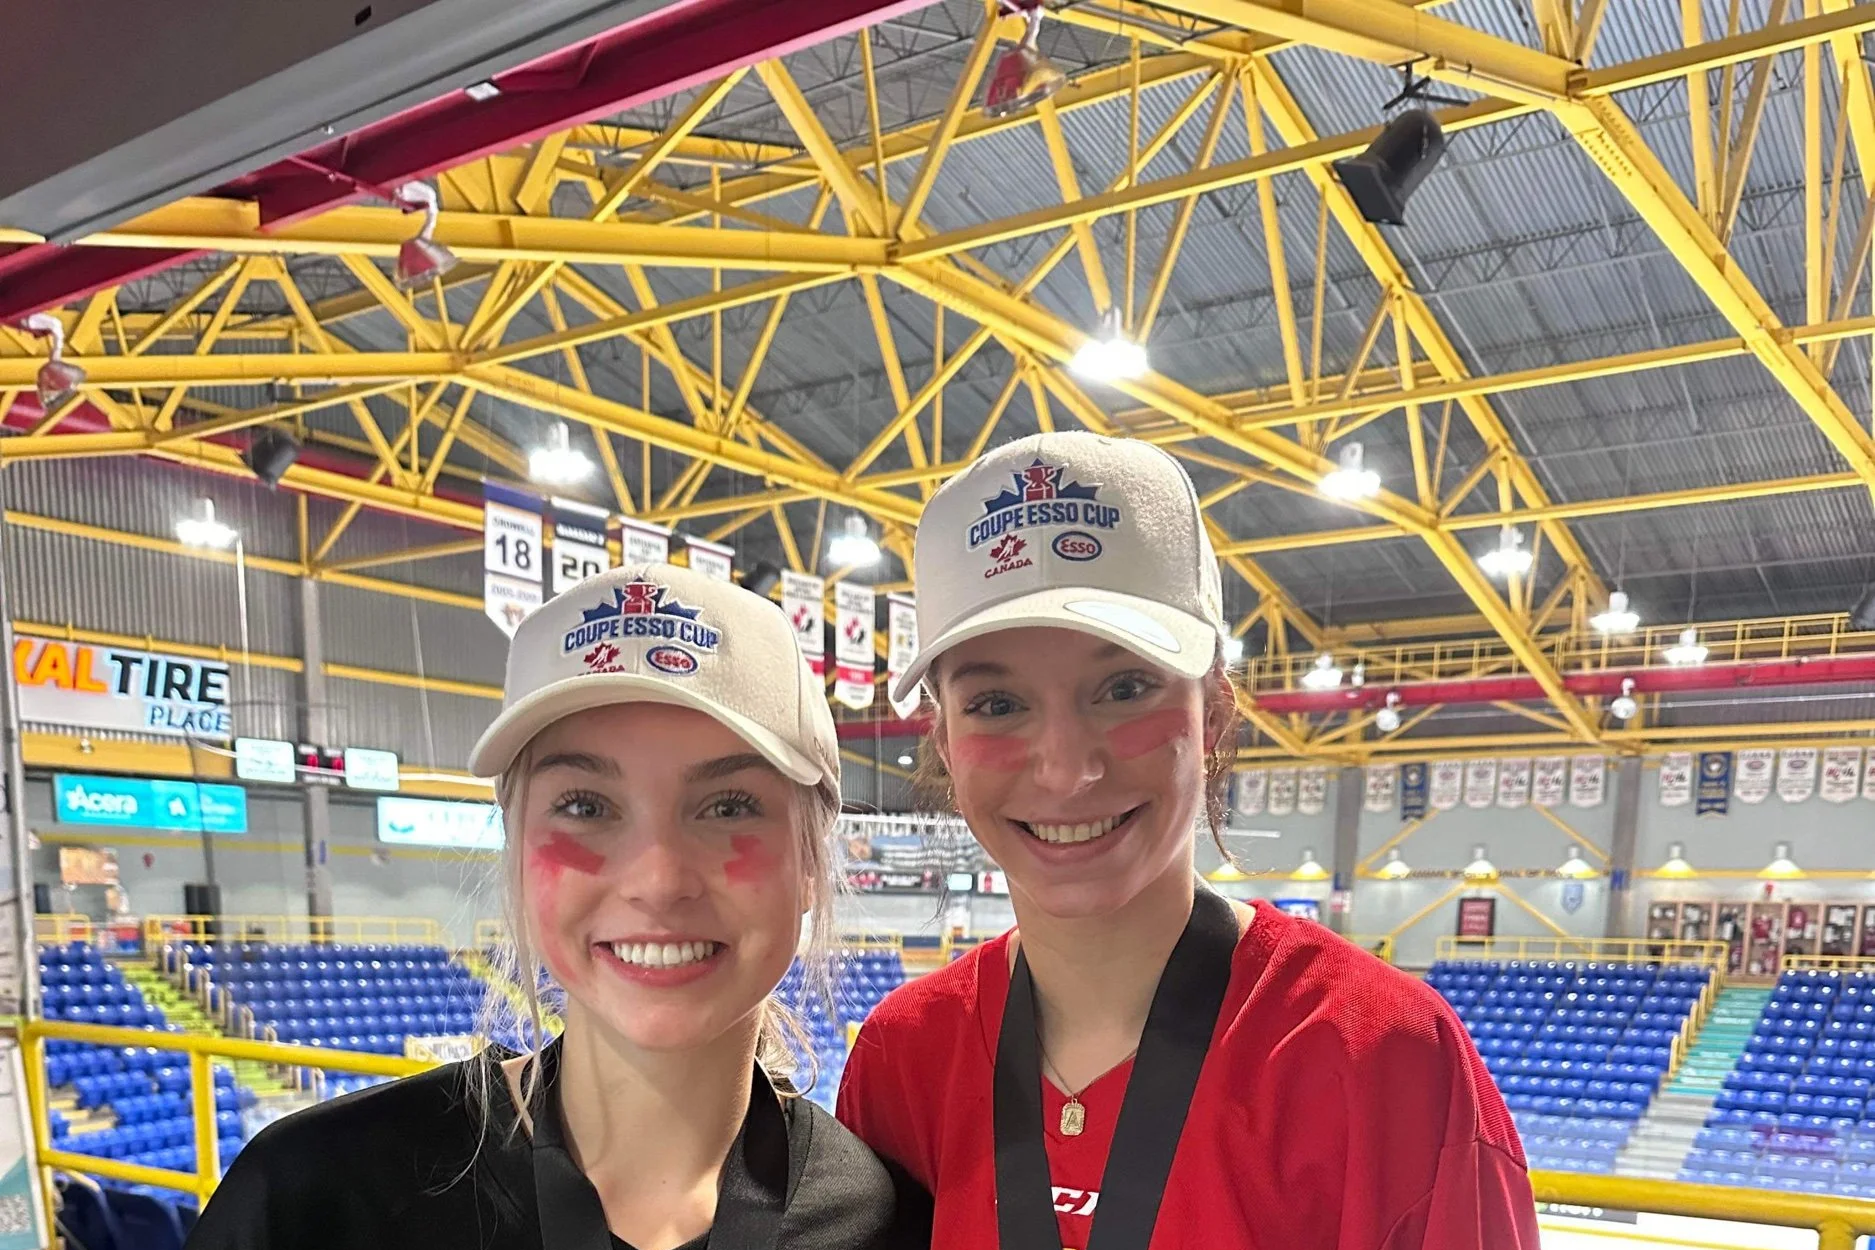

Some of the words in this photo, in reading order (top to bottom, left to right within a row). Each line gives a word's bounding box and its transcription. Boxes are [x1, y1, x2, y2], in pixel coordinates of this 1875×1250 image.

[970, 507, 1023, 546] COUPE
[1028, 502, 1079, 525] ESSO
[1083, 503, 1120, 529] CUP
[495, 533, 531, 570] 18
[984, 558, 1033, 579] CANADA
[565, 618, 619, 651] COUPE
[623, 616, 675, 639] ESSO
[680, 620, 719, 648] CUP
[111, 654, 230, 705] TIRE
[151, 705, 232, 733] PLACE
